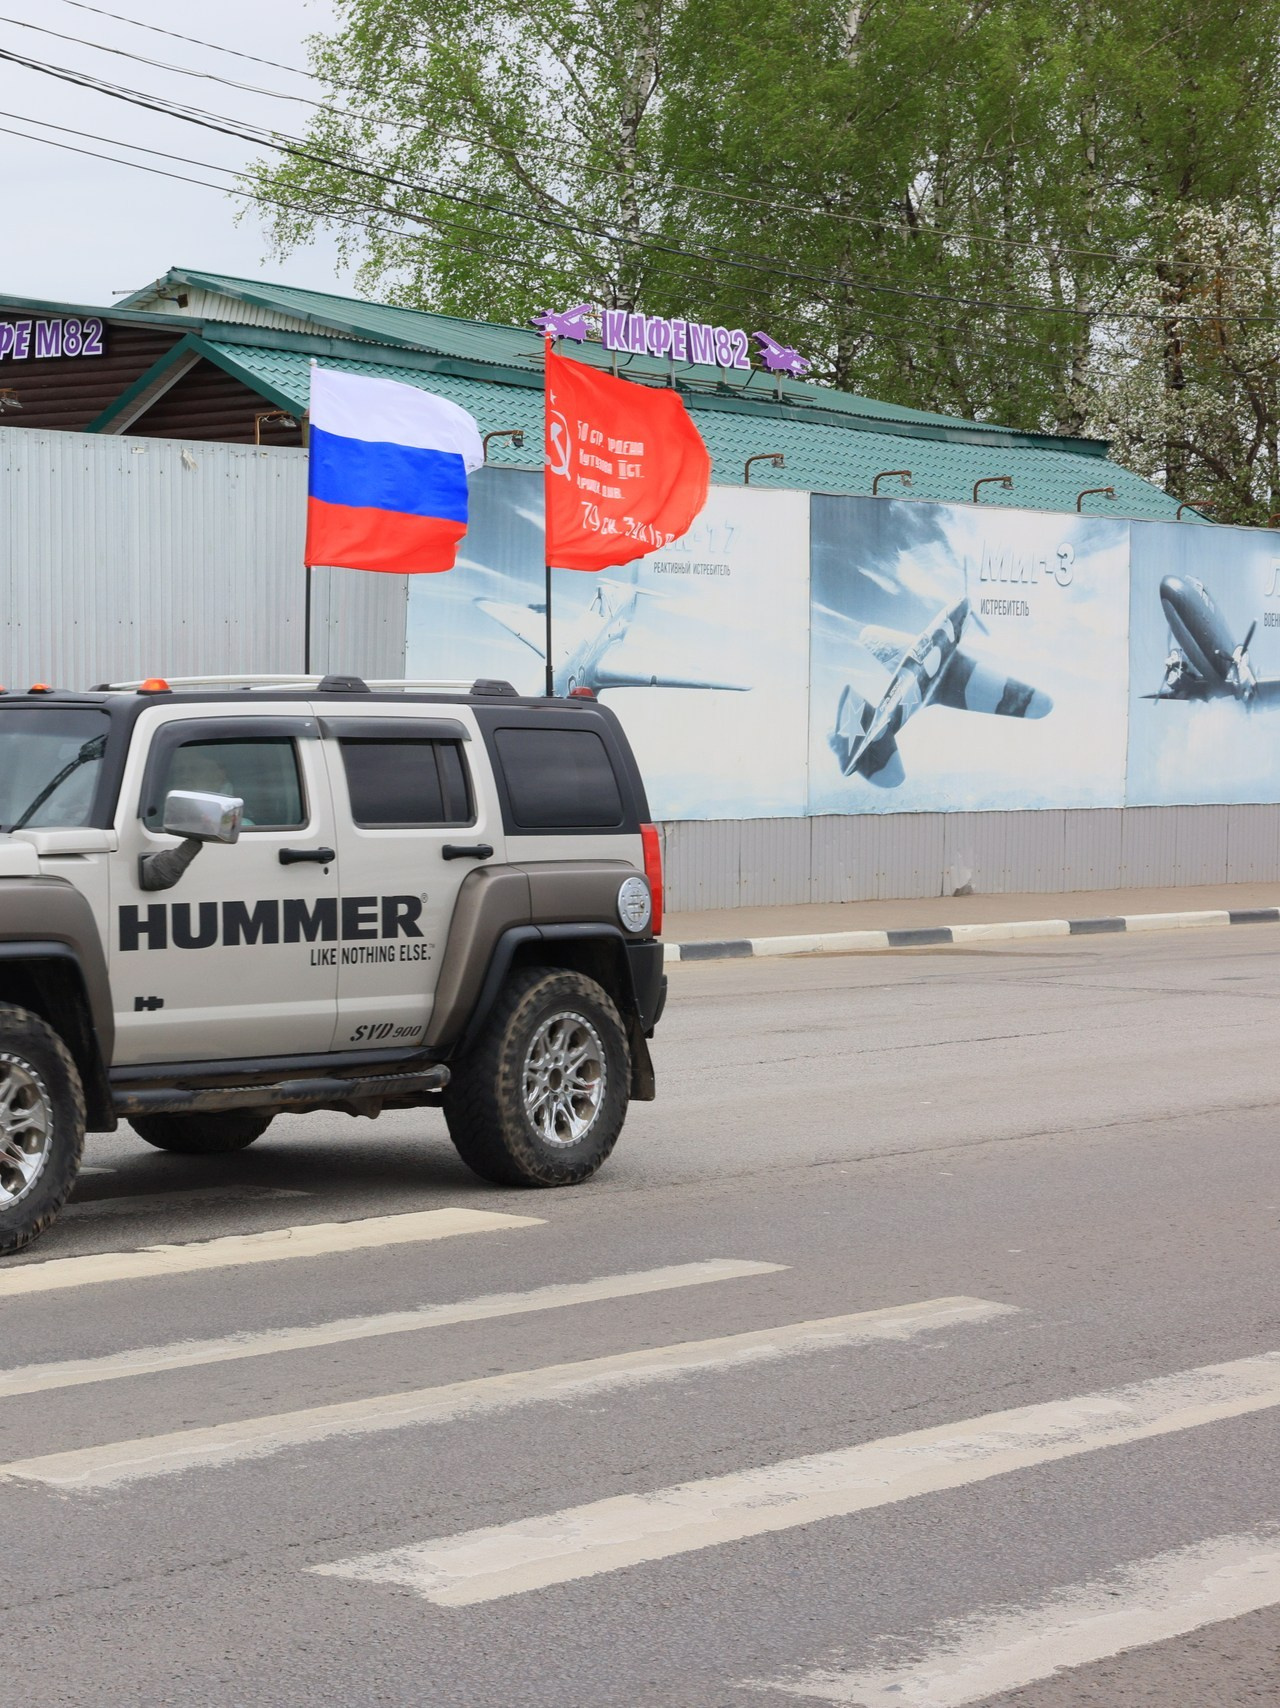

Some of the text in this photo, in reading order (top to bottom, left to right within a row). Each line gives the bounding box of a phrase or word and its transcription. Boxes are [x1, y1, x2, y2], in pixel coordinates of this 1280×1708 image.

[35, 317, 103, 359] М82
[602, 310, 751, 370] КАФЕ М82
[581, 501, 600, 532] 79
[653, 561, 731, 576] РЕАКТИВНЫЙ ИСТРЕБИТЕЛЬ
[980, 598, 1030, 617] ИСТРЕБИТЕЛЬ
[118, 895, 425, 951] HUMMER
[310, 943, 431, 966] LIKE NOTHING ELSE.
[392, 1025, 422, 1038] 900
